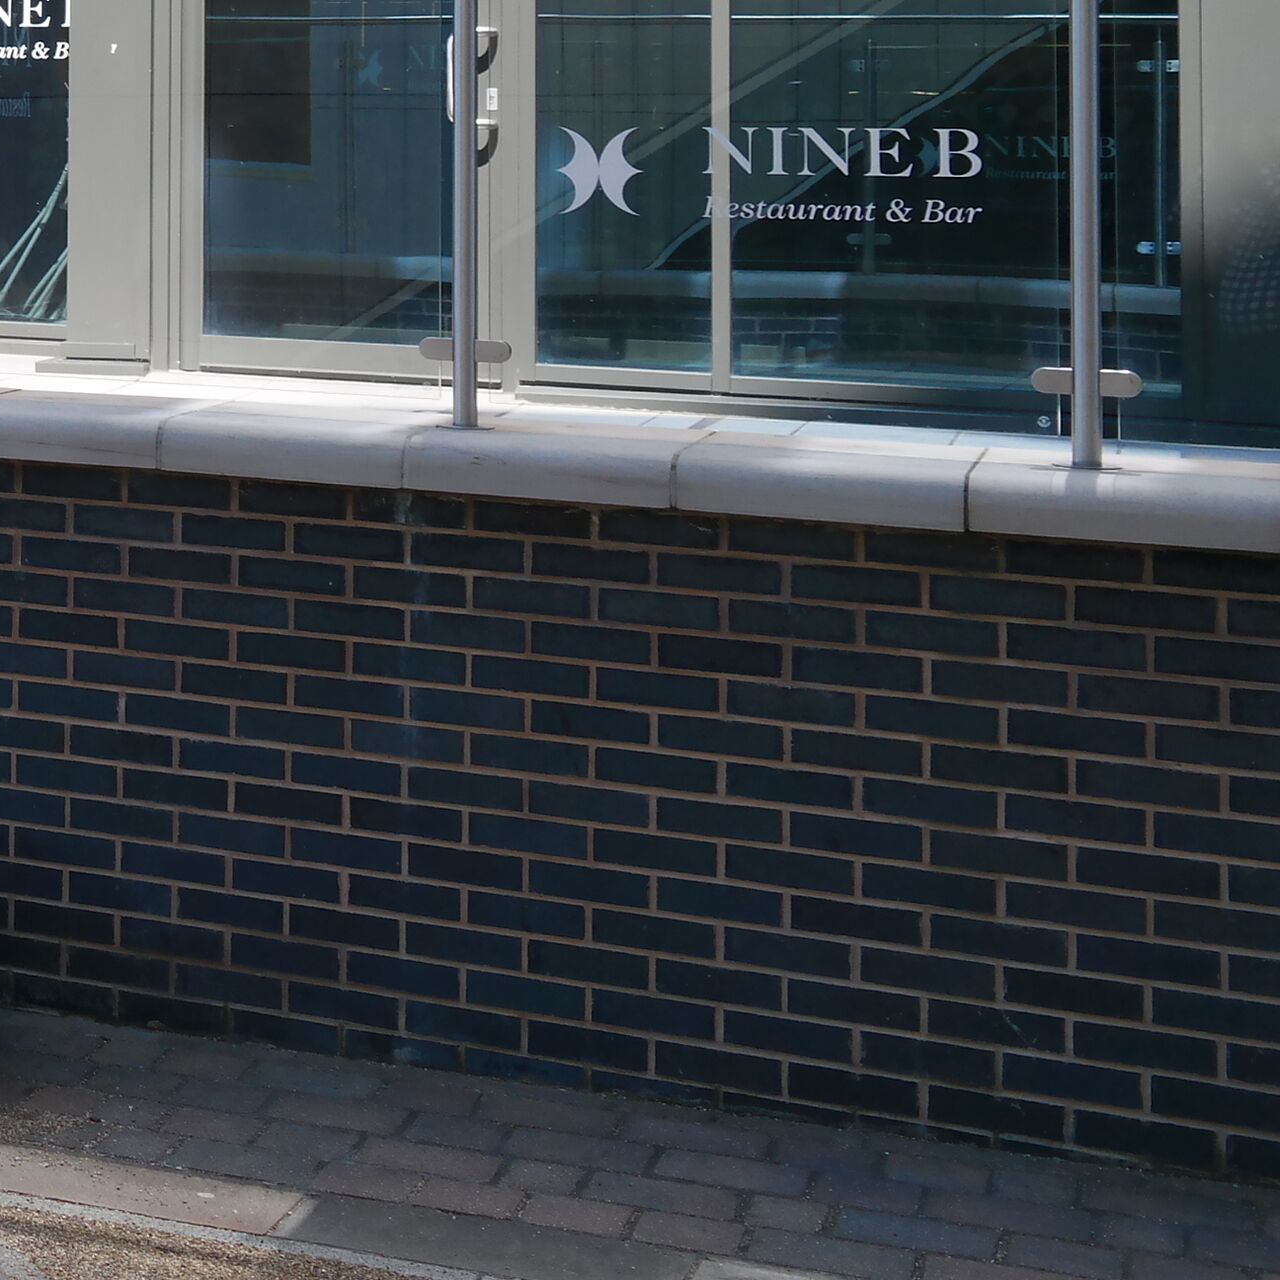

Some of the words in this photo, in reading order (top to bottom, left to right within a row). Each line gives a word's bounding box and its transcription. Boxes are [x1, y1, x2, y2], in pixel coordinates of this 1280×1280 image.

[31, 41, 49, 60] &
[702, 126, 913, 177] NINE
[933, 127, 983, 178] B
[703, 195, 876, 222] Restaurant
[885, 197, 912, 223] &
[921, 198, 983, 224] Bar
